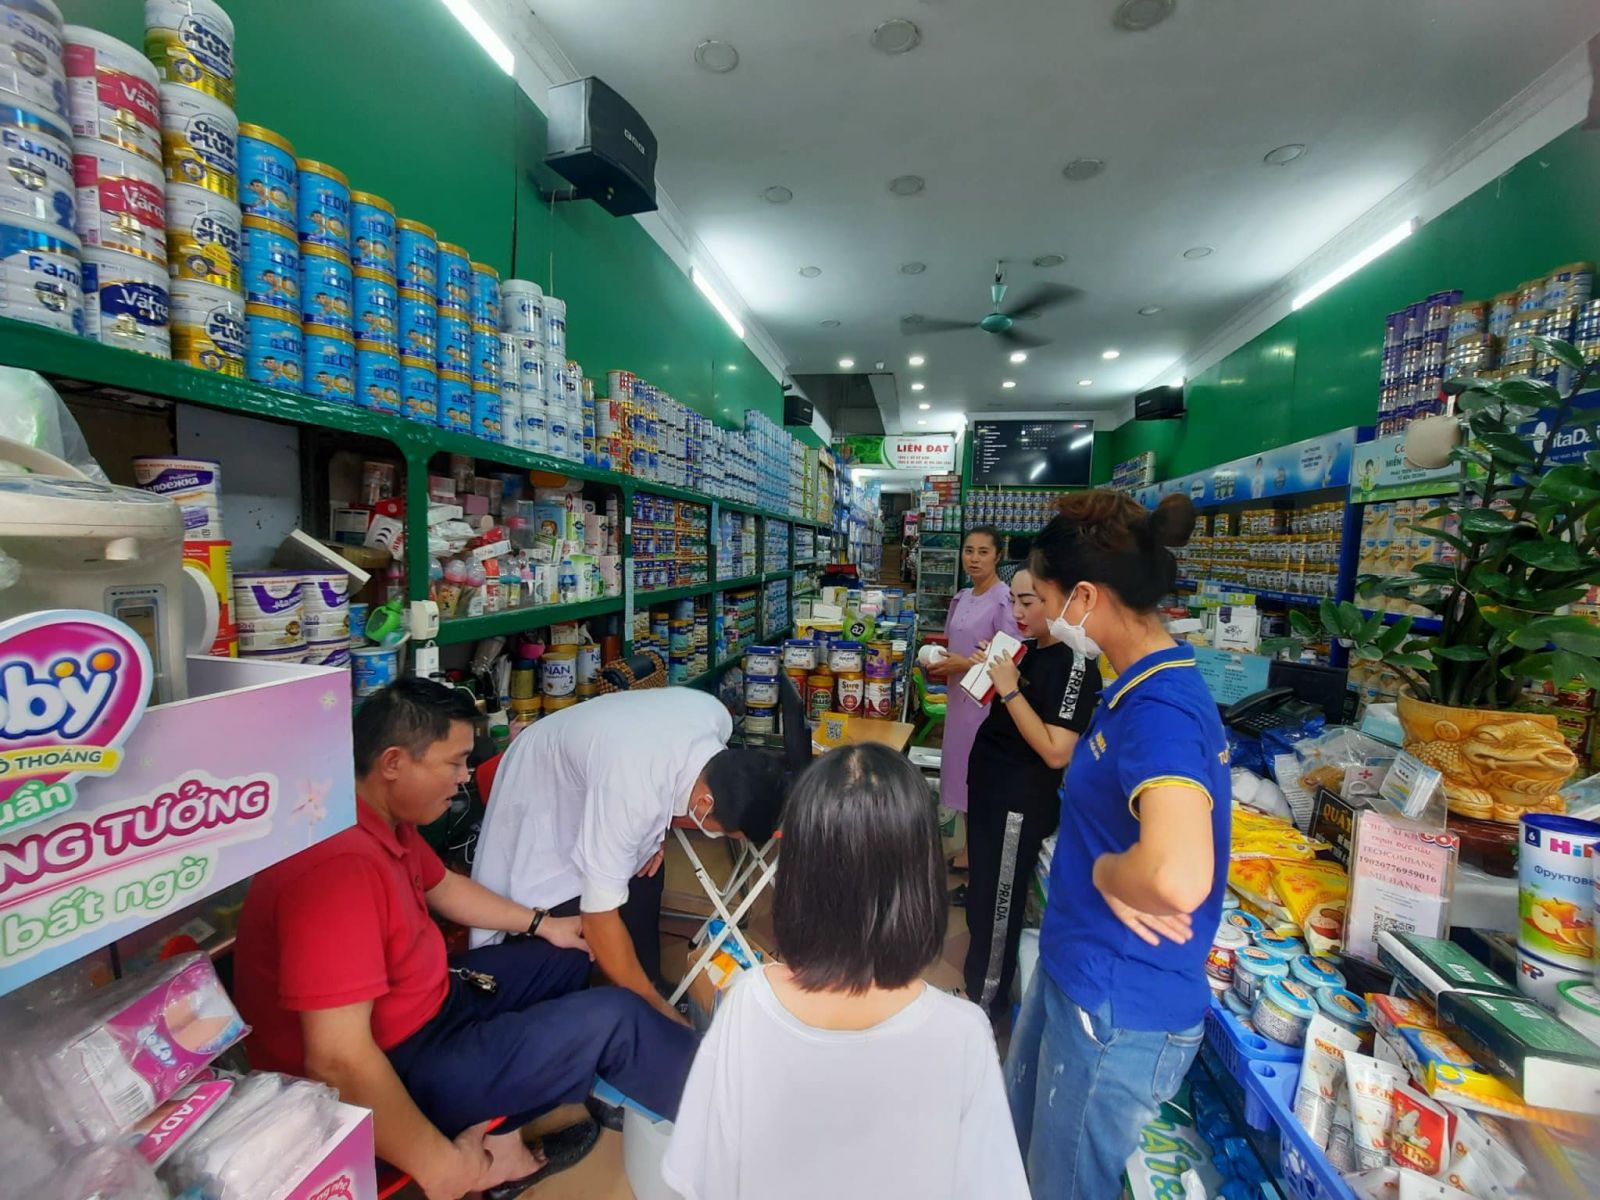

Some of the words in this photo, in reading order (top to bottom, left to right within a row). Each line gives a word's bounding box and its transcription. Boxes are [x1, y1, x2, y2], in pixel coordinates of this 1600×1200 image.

[143, 477, 200, 493] алоежка
[544, 665, 571, 676] NAN
[1061, 667, 1086, 717] PRADA
[14, 748, 102, 770] THOÁNG
[0, 783, 70, 827] uần
[1527, 831, 1537, 842] 6
[3, 886, 104, 956] bất
[115, 856, 207, 914] ngờ
[996, 882, 1012, 922] PRADA
[149, 1094, 207, 1145] LADY
